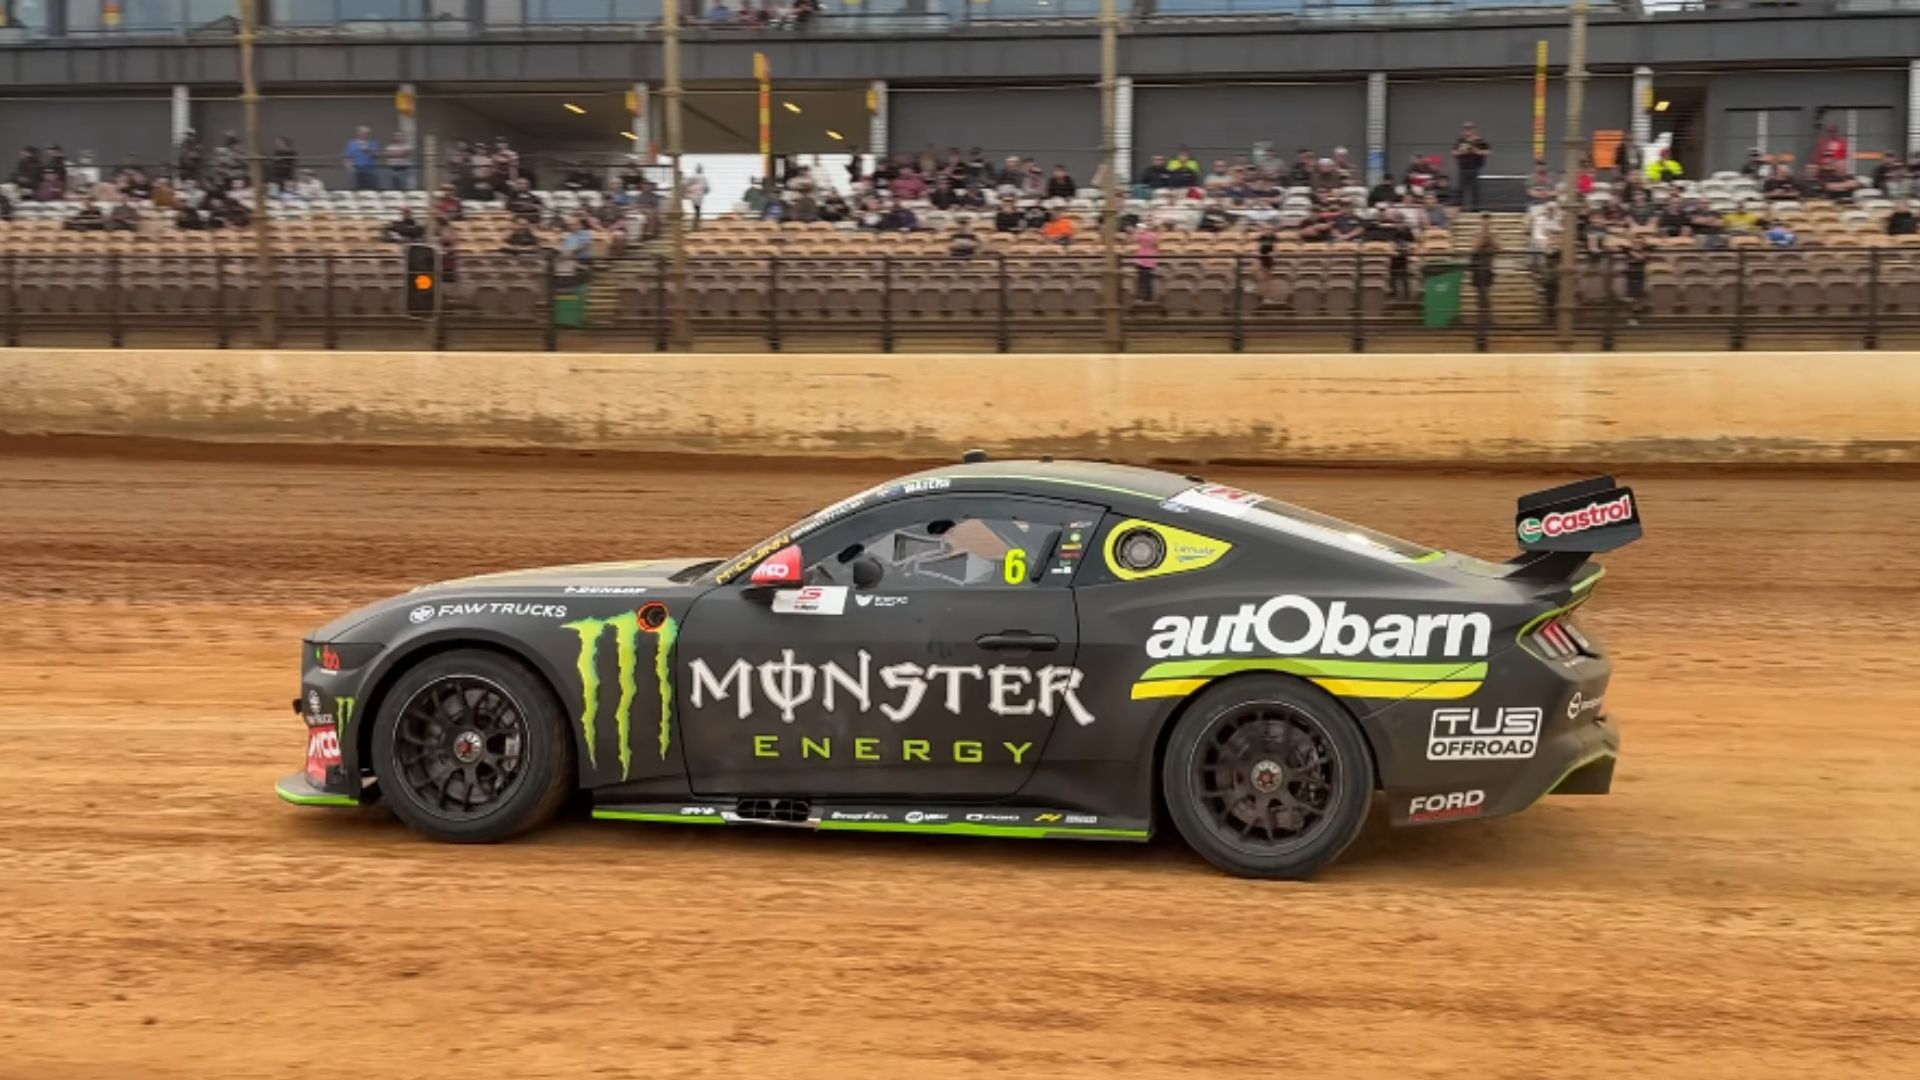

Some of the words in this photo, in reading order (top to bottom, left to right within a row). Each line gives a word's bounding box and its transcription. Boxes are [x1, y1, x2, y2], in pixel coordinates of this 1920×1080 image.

[1542, 495, 1631, 536] Castrol
[1005, 548, 1026, 585] 6
[438, 604, 487, 617] FAW
[490, 603, 567, 618] TRUCKS
[1438, 708, 1536, 734] TUS
[753, 735, 1033, 764] ENERGY
[1431, 740, 1535, 756] OFFROAD
[1409, 790, 1485, 815] FORD
